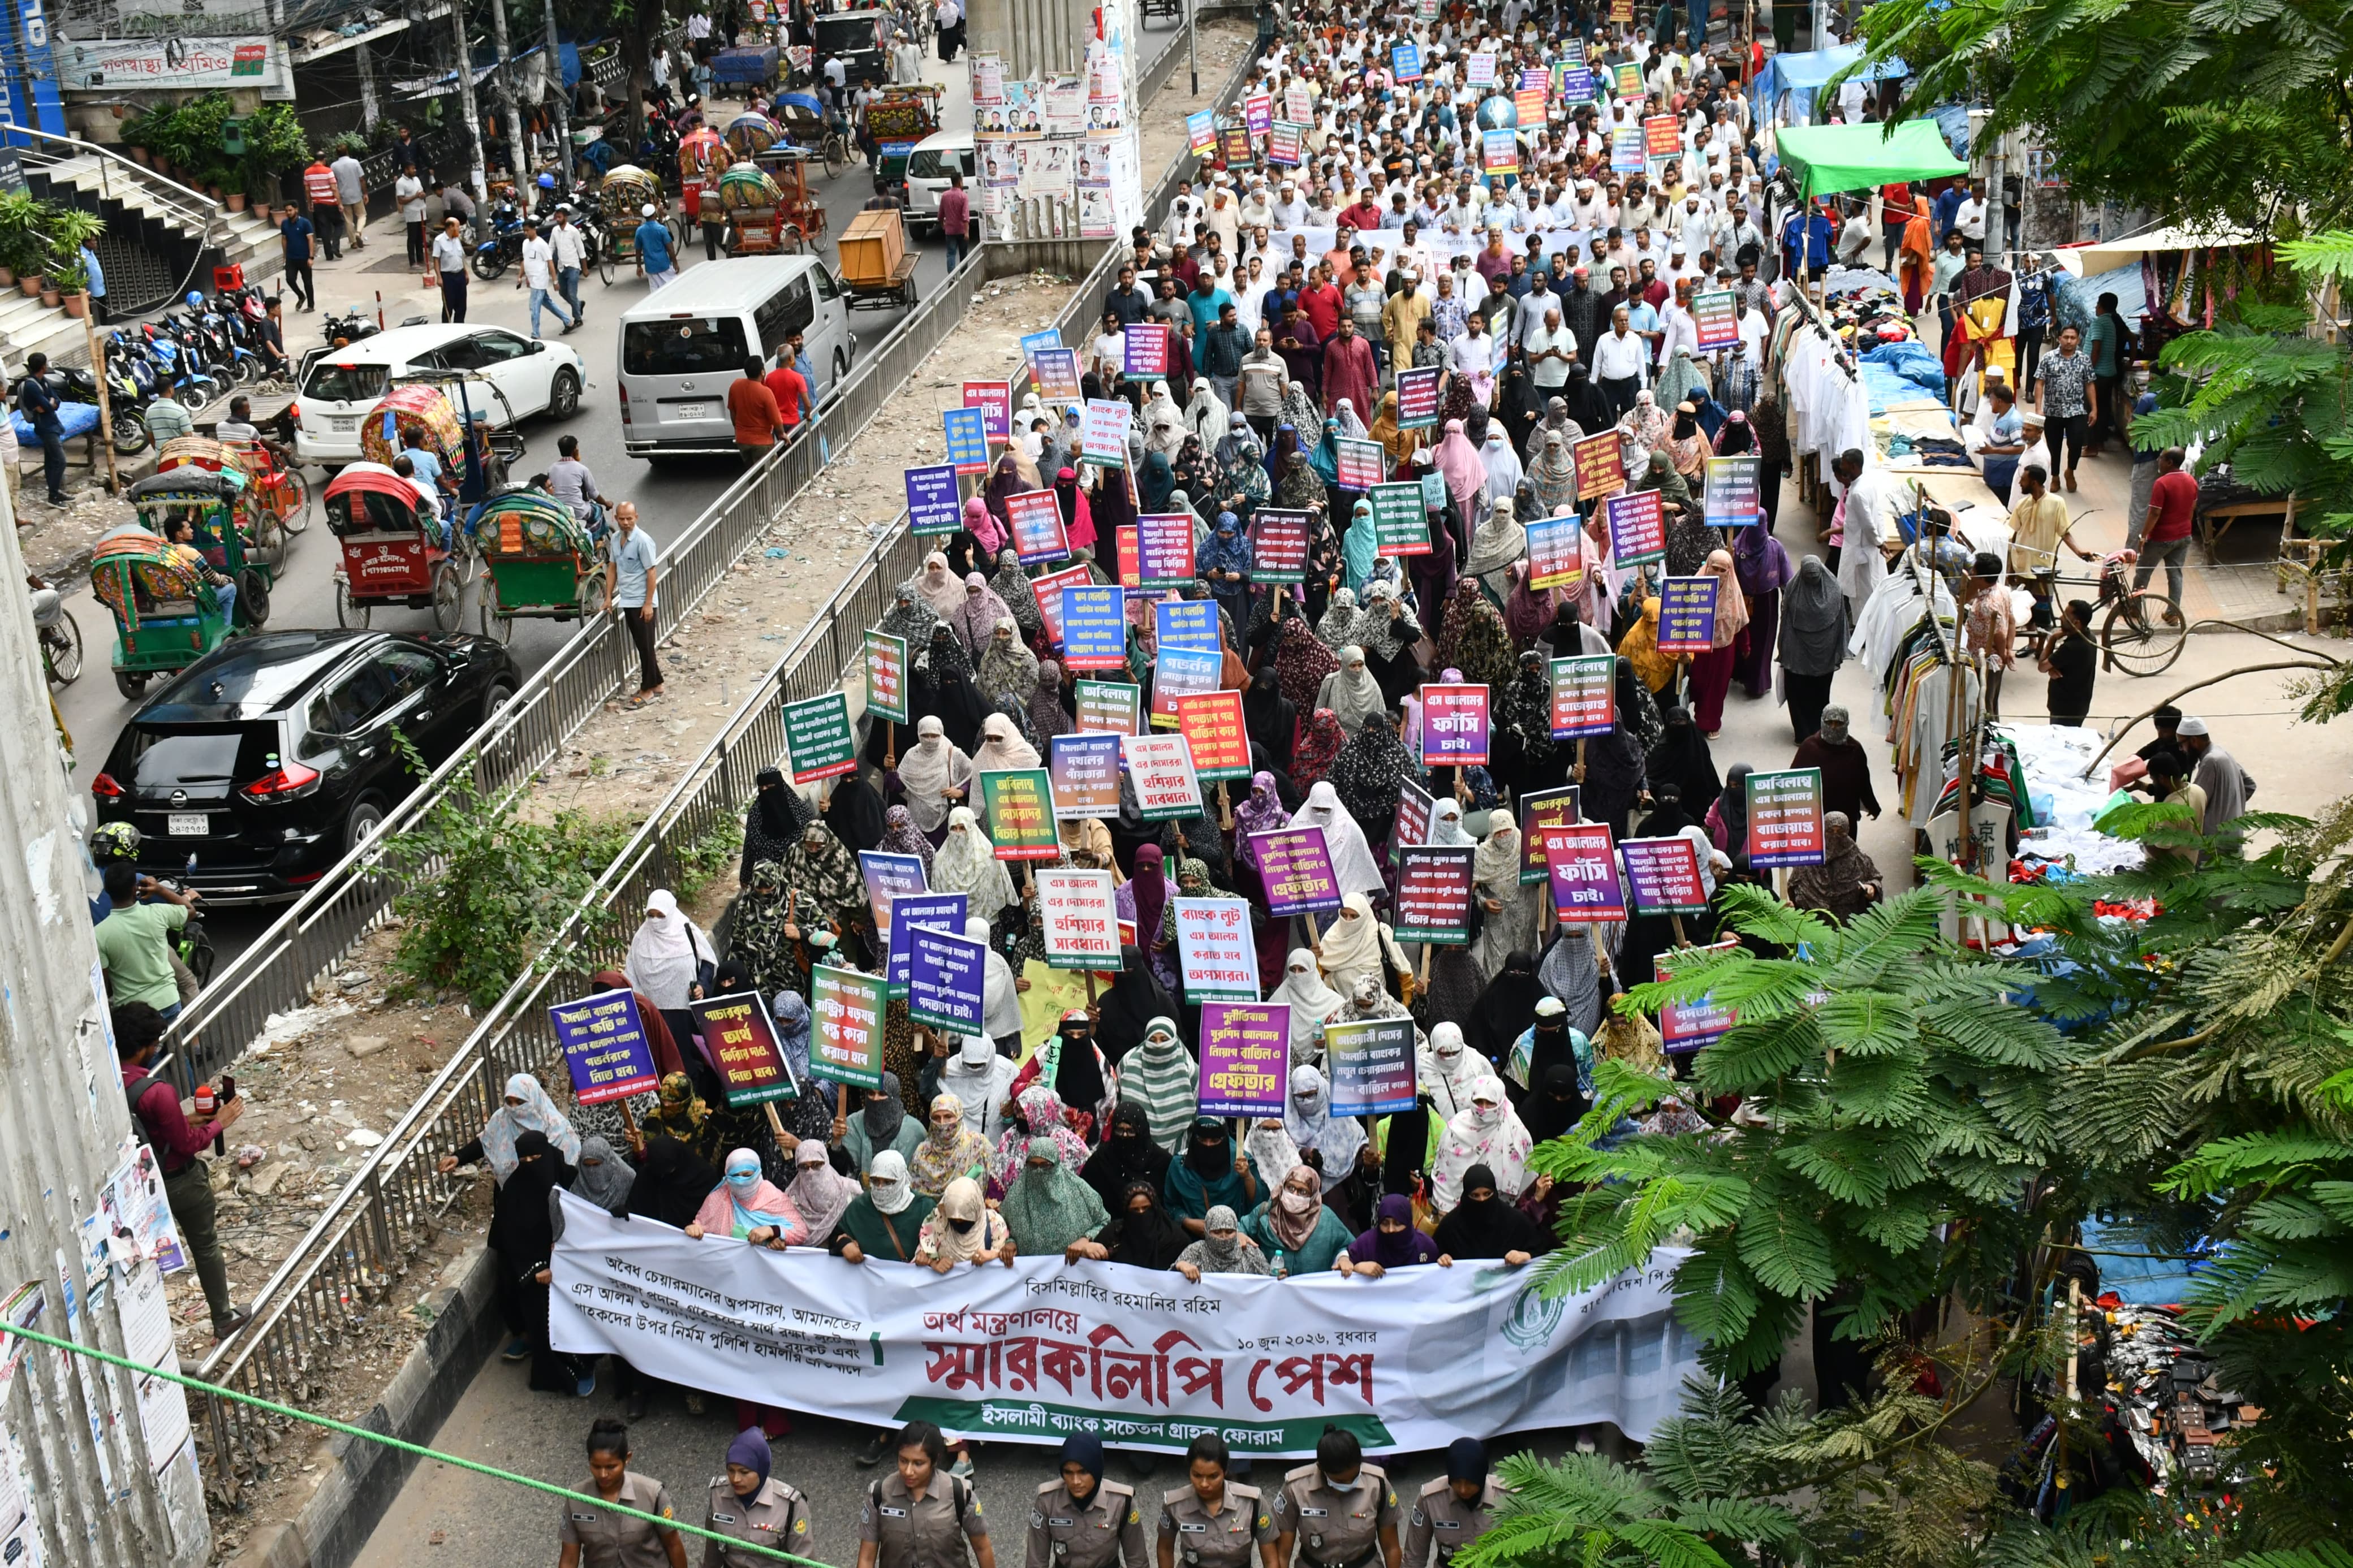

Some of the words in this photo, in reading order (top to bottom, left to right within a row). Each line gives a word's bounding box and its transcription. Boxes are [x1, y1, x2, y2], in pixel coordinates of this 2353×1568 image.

[1533, 523, 1574, 538] গভর্নর
[1532, 546, 1577, 563] পদত্যাগ
[1542, 560, 1568, 574] চাই।
[1165, 656, 1213, 672] গভর্নর
[1557, 660, 1608, 675] অবিলম্বে
[1572, 675, 1608, 685] আলমের
[1083, 685, 1132, 702] অবিলম্বে
[1581, 687, 1606, 697] সম্পদ
[1428, 695, 1442, 706] এস
[1444, 695, 1483, 706] আলমের
[1558, 699, 1607, 712] বাজেয়াপ্ত
[1432, 711, 1480, 733] ফাঁসি
[1441, 737, 1470, 750] চাই।
[1067, 755, 1105, 766] দখলের
[996, 776, 1035, 792] অবিলম্বে
[1143, 774, 1185, 788] হুশিয়ার
[1754, 775, 1813, 791] অবিলম্বে
[1145, 792, 1191, 805] সাবধান।
[1755, 794, 1770, 804] এস
[1773, 791, 1813, 803] আলমের
[1757, 809, 1782, 818] সকল
[1784, 807, 1812, 818] সম্পদ
[1756, 819, 1815, 835] বাজেয়াপ্ত
[1547, 838, 1564, 850] এস
[1566, 835, 1607, 850] আলমের
[1291, 858, 1318, 872] বাতিল
[1556, 856, 1608, 882] ফাঁসি
[1050, 879, 1065, 888] এস
[1069, 879, 1097, 888] আলম
[1272, 878, 1329, 896] গ্রেফতার
[1571, 888, 1604, 904] চাই।
[1054, 914, 1105, 933] হুশিয়ার
[1180, 909, 1217, 921] ব্যাংক
[1221, 908, 1240, 927] লুট
[1190, 932, 1205, 941] এস
[1208, 931, 1238, 941] আলম
[919, 939, 928, 948] এস
[929, 941, 953, 955] আলমের
[1054, 938, 1110, 951] সাবধান।
[1192, 951, 1221, 960] করতে
[1224, 951, 1241, 961] হবে
[841, 983, 860, 996] ব্যাংক
[861, 986, 876, 1001] নিয়ে
[559, 1007, 592, 1023] ইসলামি
[593, 1000, 627, 1017] ব্যাংকের
[704, 1003, 752, 1022] পাচারকৃত
[918, 997, 951, 1014] পদত্যাগ
[954, 1003, 973, 1018] চাই।
[721, 1022, 753, 1044] অর্থ
[821, 1021, 841, 1040] বন্ধ
[1242, 1030, 1279, 1041] আলমের
[1336, 1029, 1376, 1046] আওয়ামী
[585, 1049, 631, 1067] গভর্নরকে
[821, 1044, 850, 1061] করতে
[851, 1051, 868, 1066] হবে
[1209, 1046, 1238, 1057] নিয়োগ
[1240, 1044, 1272, 1060] বাতিল
[1273, 1050, 1281, 1059] ও
[1339, 1048, 1368, 1061] ইসলামি
[1370, 1047, 1401, 1060] ব্যাংকের
[589, 1069, 614, 1084] নিতে
[615, 1065, 637, 1078] হবে।
[728, 1069, 752, 1083] দিতে
[753, 1065, 777, 1080] হবে।
[1209, 1073, 1276, 1093] গ্রেফতার
[605, 1256, 641, 1278] অবৈধ
[645, 1270, 721, 1303] চেয়ারম্যানের
[723, 1295, 786, 1321] অপসারণ,
[791, 1308, 861, 1332] আমানতের
[1025, 1276, 1108, 1303] বিসমিল্লাহির
[1112, 1291, 1176, 1312] রহমানির
[1182, 1295, 1221, 1315] রহিম
[572, 1282, 594, 1299] এস
[598, 1286, 634, 1306] আলম
[833, 1347, 860, 1359] এবং
[923, 1303, 969, 1333] অর্থ
[971, 1308, 1080, 1336] মন্ত্রণালয়ে
[636, 1312, 667, 1336] উপর
[671, 1320, 706, 1344] নির্মম
[709, 1332, 749, 1353] পুলিশি
[1238, 1337, 1253, 1350] ১০
[1258, 1336, 1279, 1351] জুন
[1285, 1333, 1329, 1346] ২০২৬,
[1334, 1331, 1377, 1346] বুধবার
[921, 1324, 1224, 1410] স্মারকলিপি
[1248, 1353, 1374, 1413] পেশ
[981, 1402, 1048, 1428] ইসলামী
[1050, 1413, 1100, 1433] ব্যাংক
[1103, 1420, 1164, 1438] সচেতন
[1222, 1428, 1284, 1445] ফোরাম
